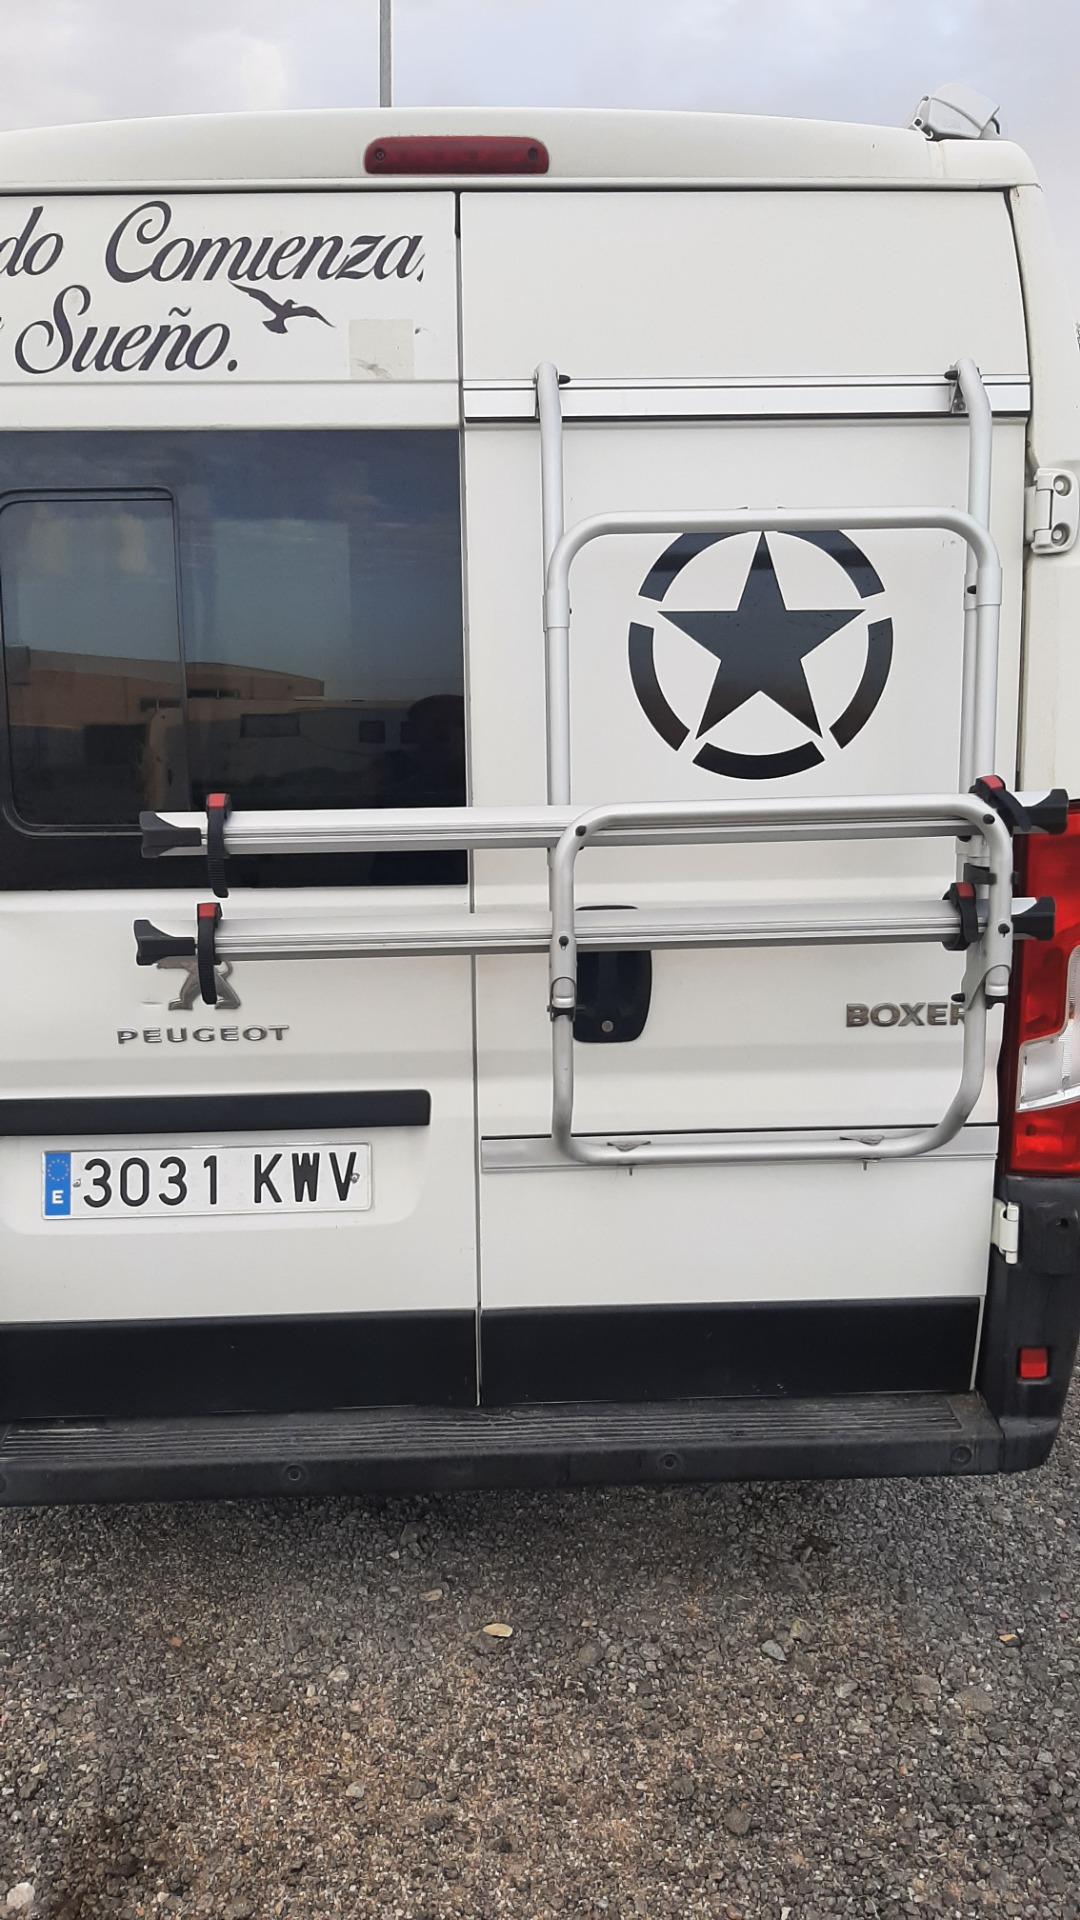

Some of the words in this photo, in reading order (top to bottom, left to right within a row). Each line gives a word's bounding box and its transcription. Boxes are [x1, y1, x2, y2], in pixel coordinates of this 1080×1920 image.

[15, 284, 238, 374] Sueño.
[117, 1025, 289, 1044] PEUGEOT
[52, 1190, 63, 1204] E
[83, 1155, 218, 1208] 3031
[253, 1152, 357, 1203] KWV
